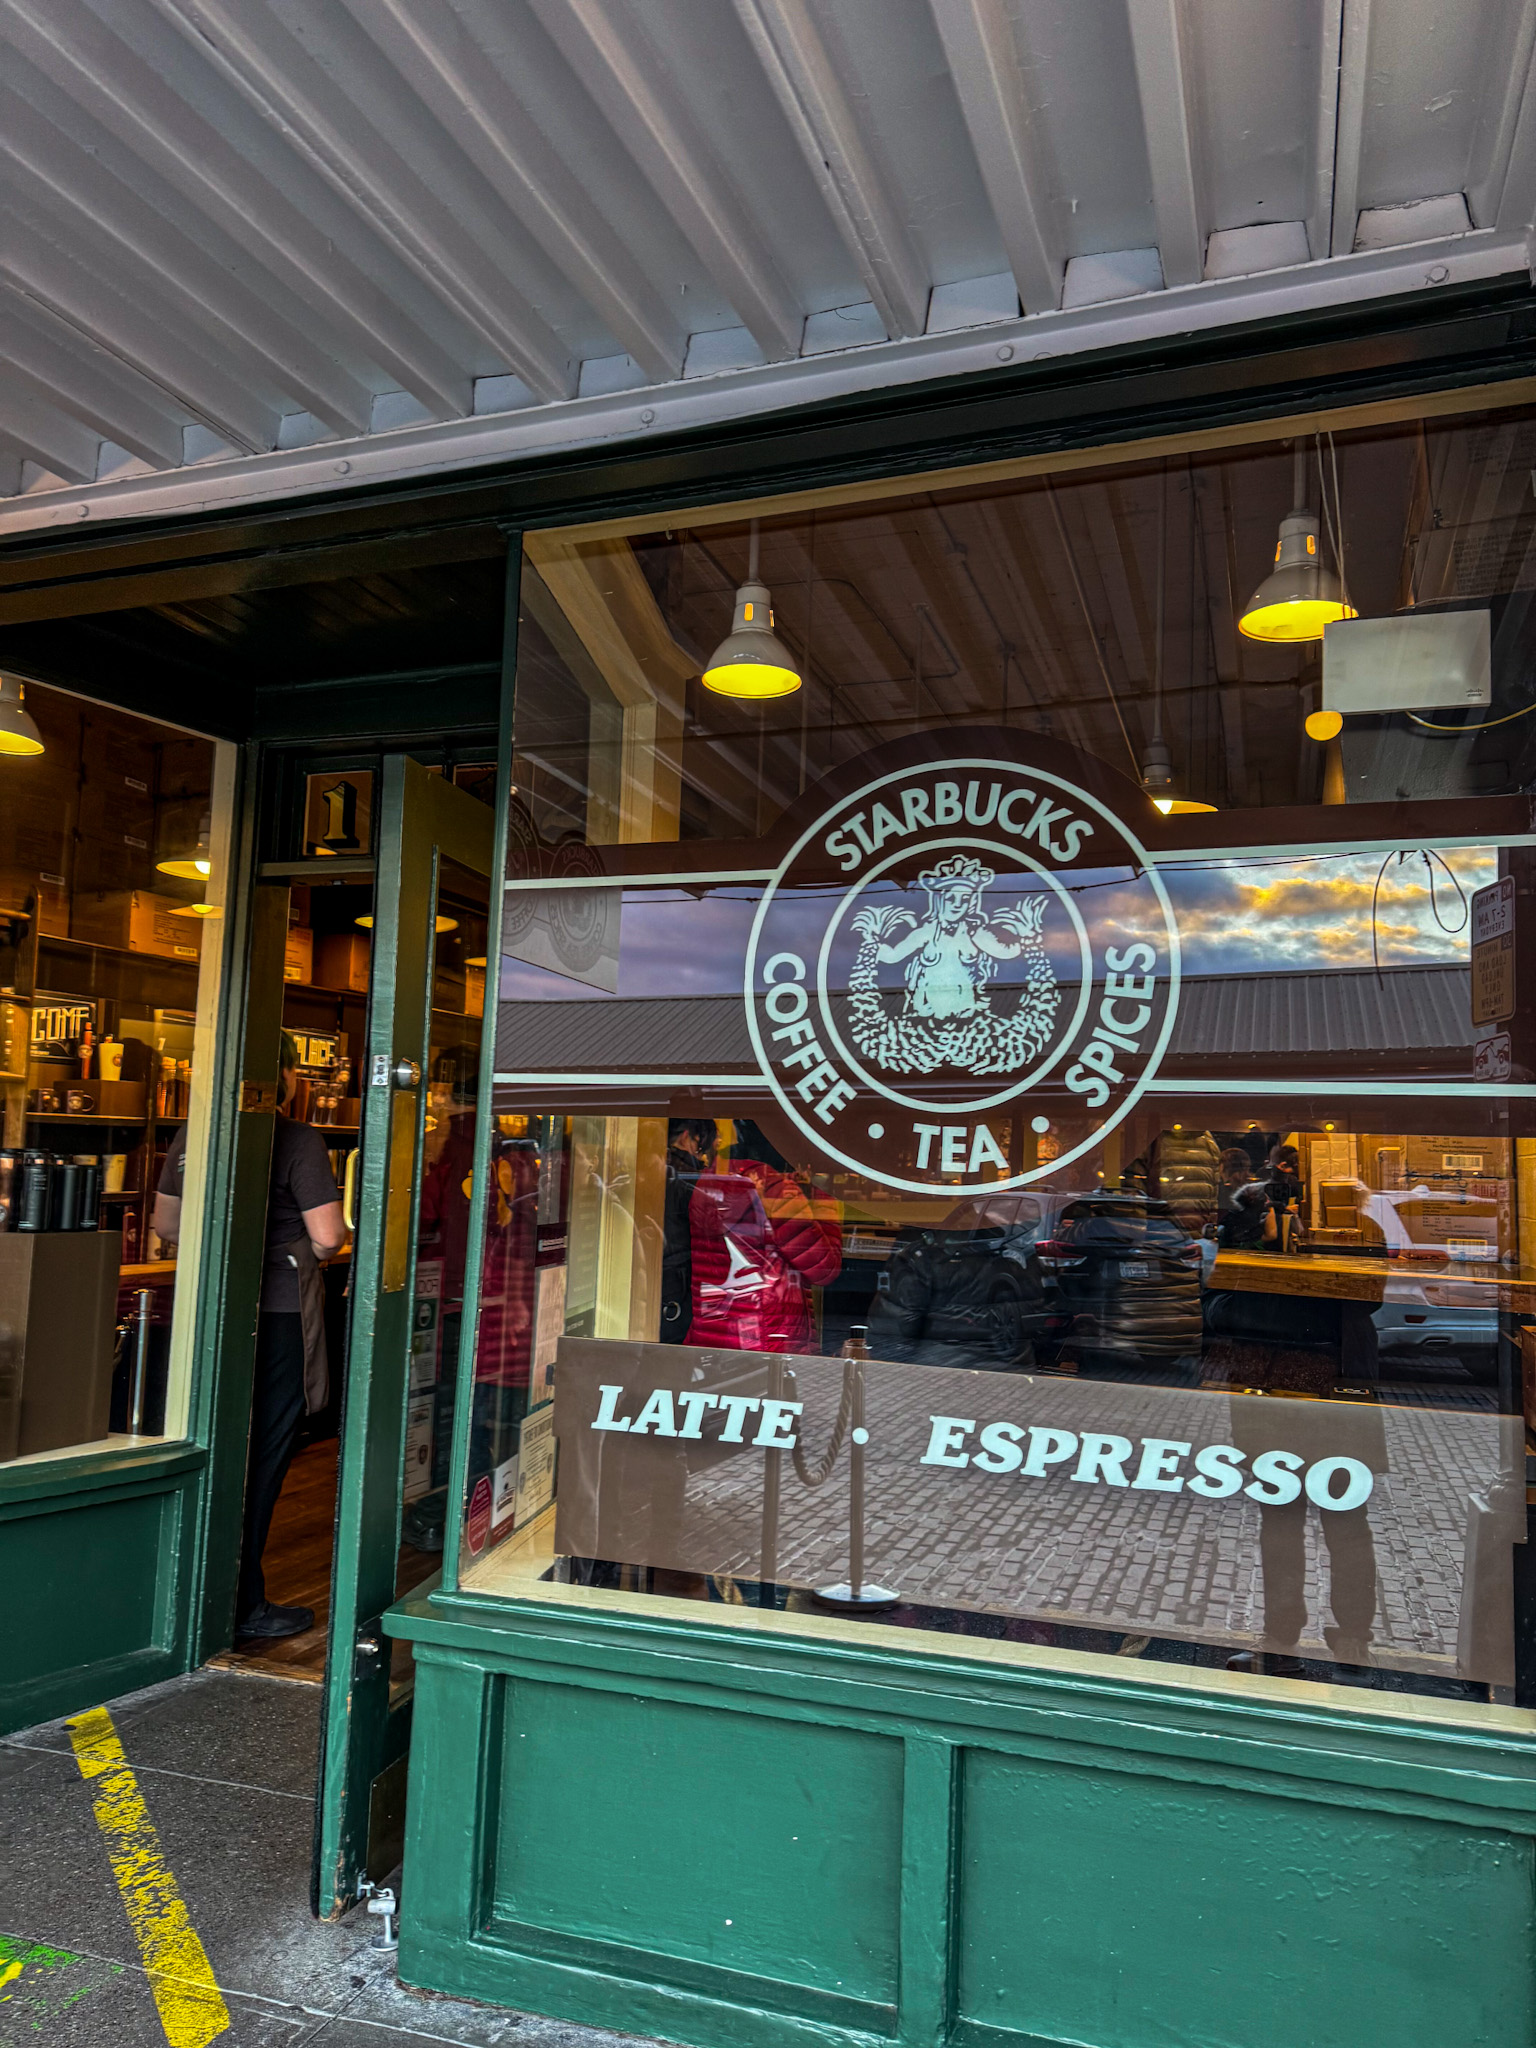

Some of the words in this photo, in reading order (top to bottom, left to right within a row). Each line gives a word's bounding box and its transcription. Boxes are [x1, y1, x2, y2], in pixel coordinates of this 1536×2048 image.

[322, 781, 360, 849] 1
[825, 780, 1094, 871] STARBUCKS
[763, 952, 857, 1125] COFFEE
[1064, 942, 1156, 1107] SPICES
[912, 1122, 1010, 1173] TEA
[591, 1384, 804, 1450] LATTE
[920, 1415, 1374, 1512] ESPRESSO
